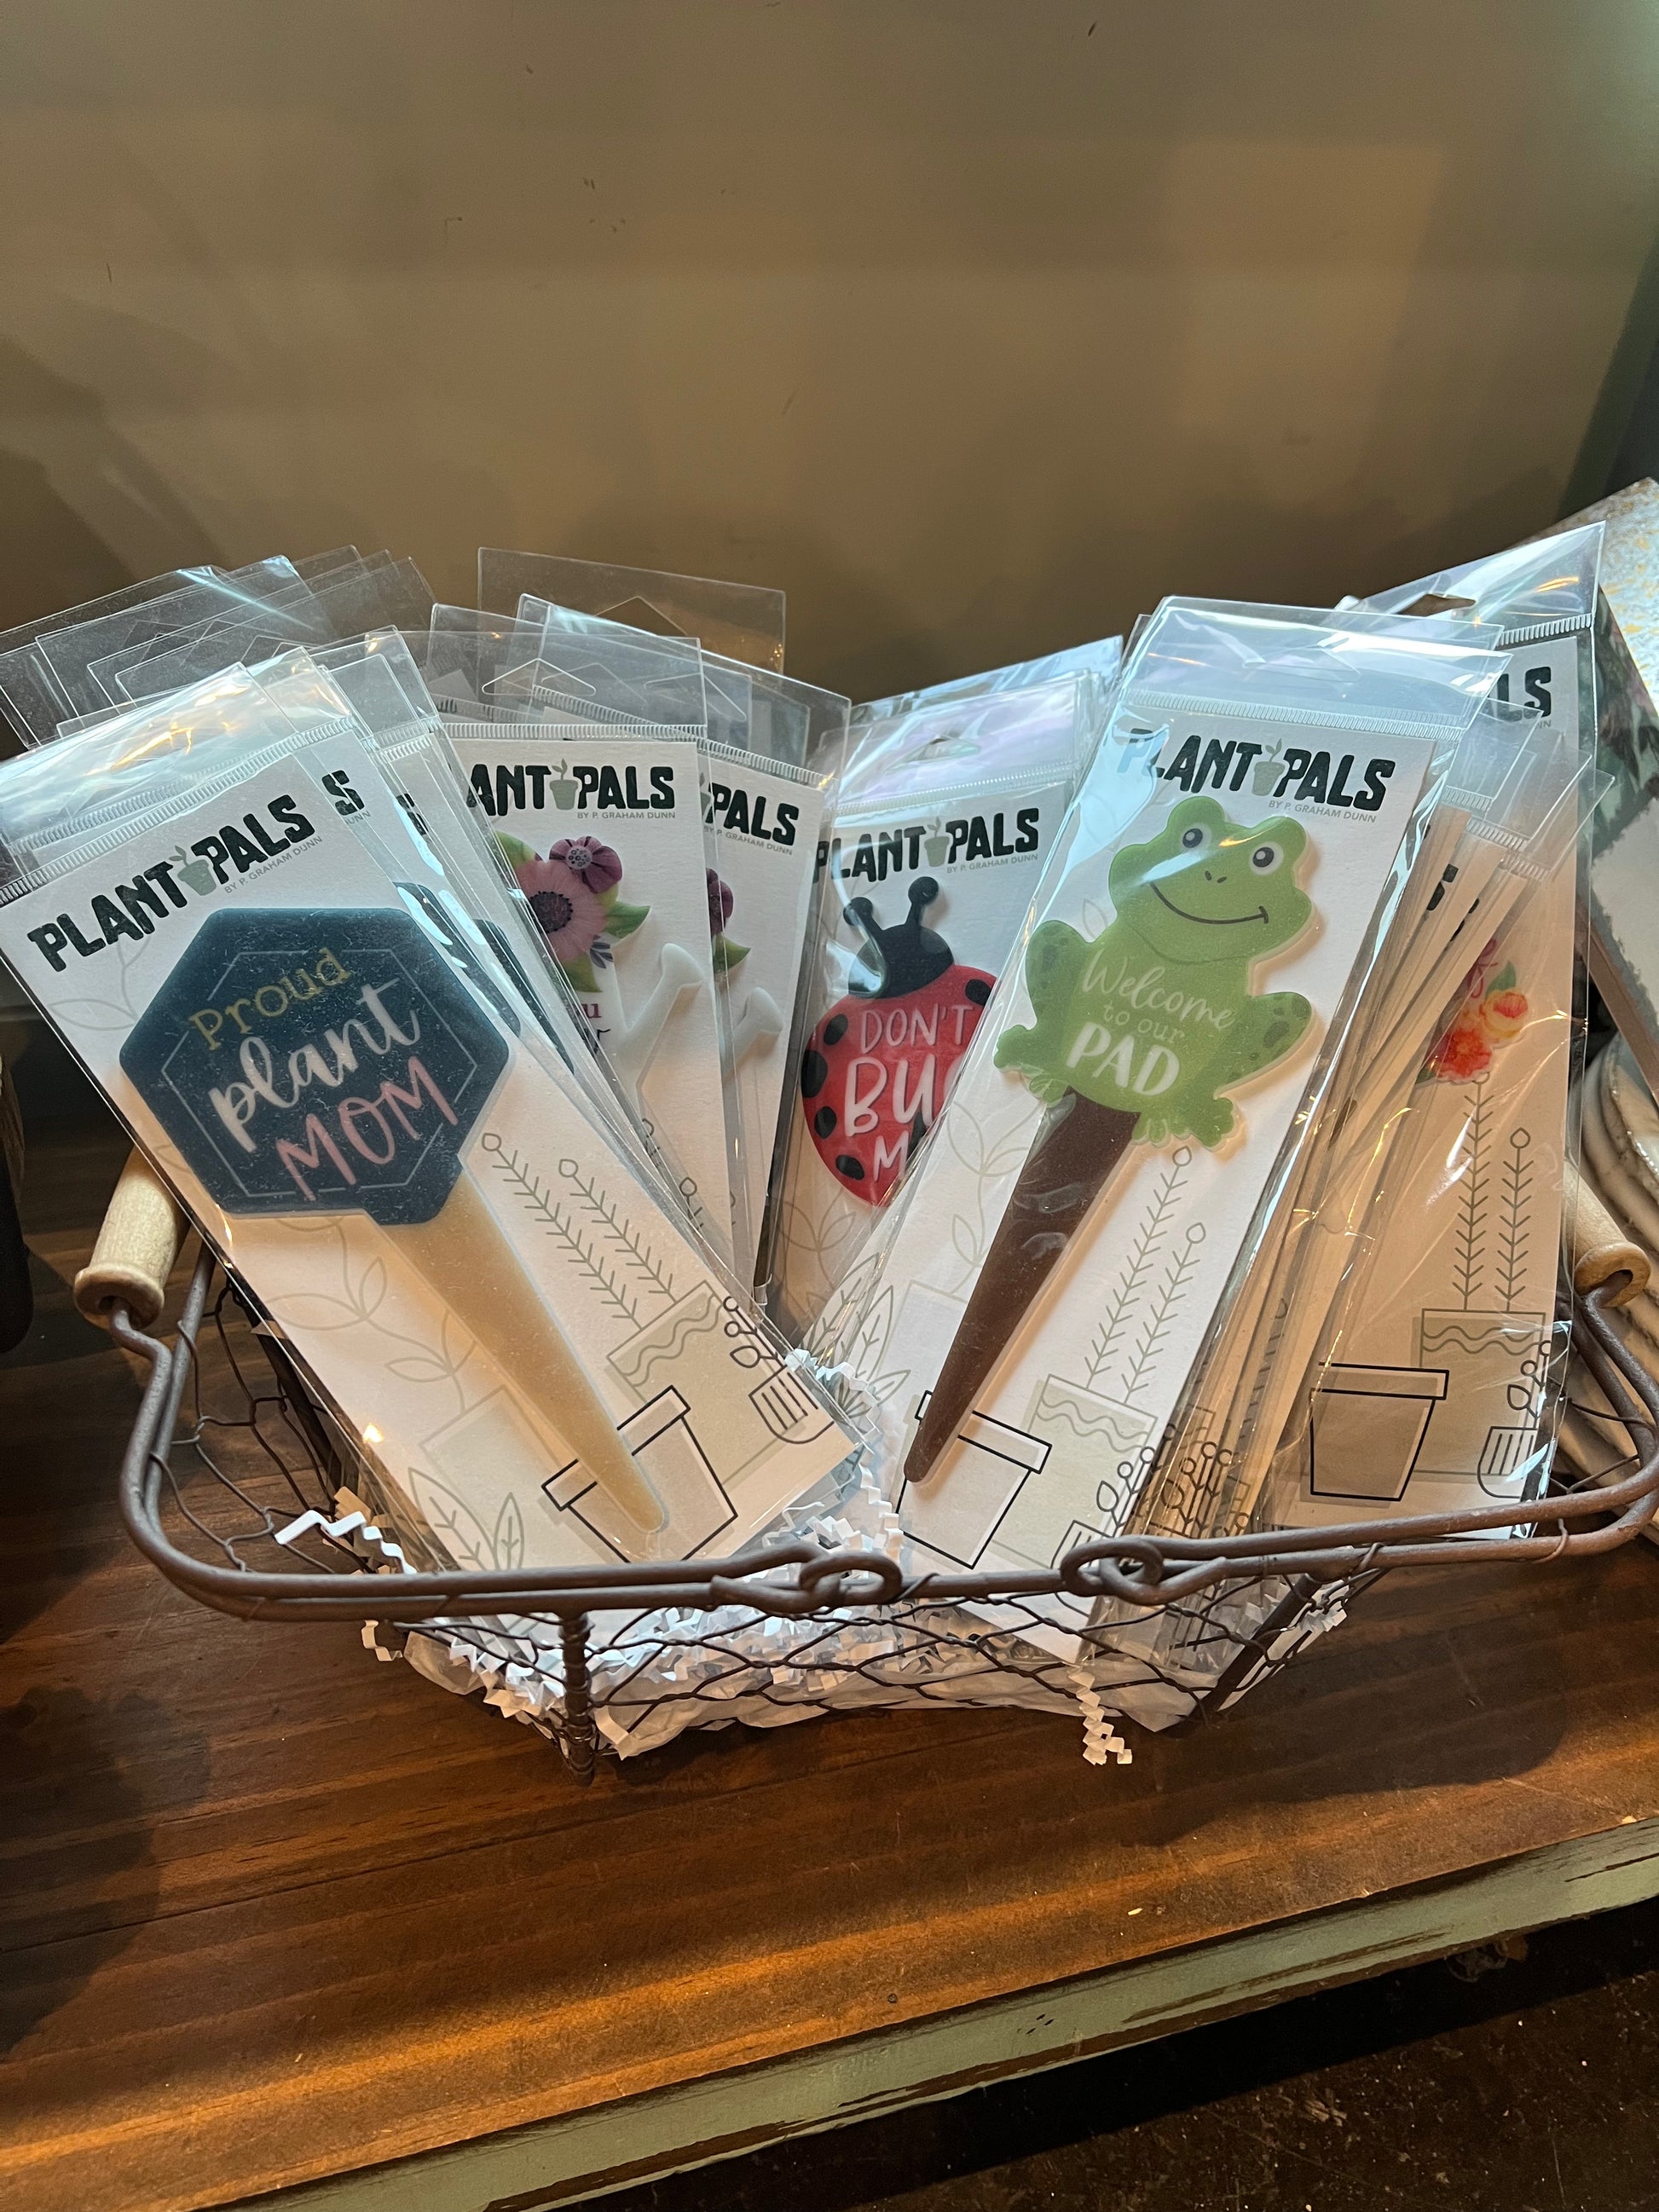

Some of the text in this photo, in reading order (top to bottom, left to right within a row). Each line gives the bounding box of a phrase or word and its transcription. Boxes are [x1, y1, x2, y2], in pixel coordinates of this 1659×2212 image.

[466, 763, 552, 817] ANT
[573, 765, 675, 810] PALS
[1273, 748, 1396, 811] PALS
[576, 811, 589, 820] BY
[602, 811, 645, 820] GRAHAM
[646, 811, 676, 820] DUNN
[704, 782, 800, 846] PALS
[945, 807, 1039, 864] PALS
[1268, 800, 1377, 823] BY P. GRAHAM DUNN
[224, 835, 323, 893] BY P. GRAHAM DUNN
[725, 831, 765, 848] GRAHAM
[766, 843, 793, 856] DUNN
[946, 854, 1038, 874] BY P. GRAHAM DUNN
[27, 861, 188, 972] PLANT
[190, 794, 315, 885] PALS
[188, 947, 351, 1051] Proud
[1082, 948, 1236, 1031] Welcome
[859, 1002, 974, 1054] DON'T
[1102, 1001, 1185, 1044] to our
[208, 978, 421, 1152] plant
[1066, 1022, 1180, 1097] PAD
[275, 1055, 459, 1201] MOM
